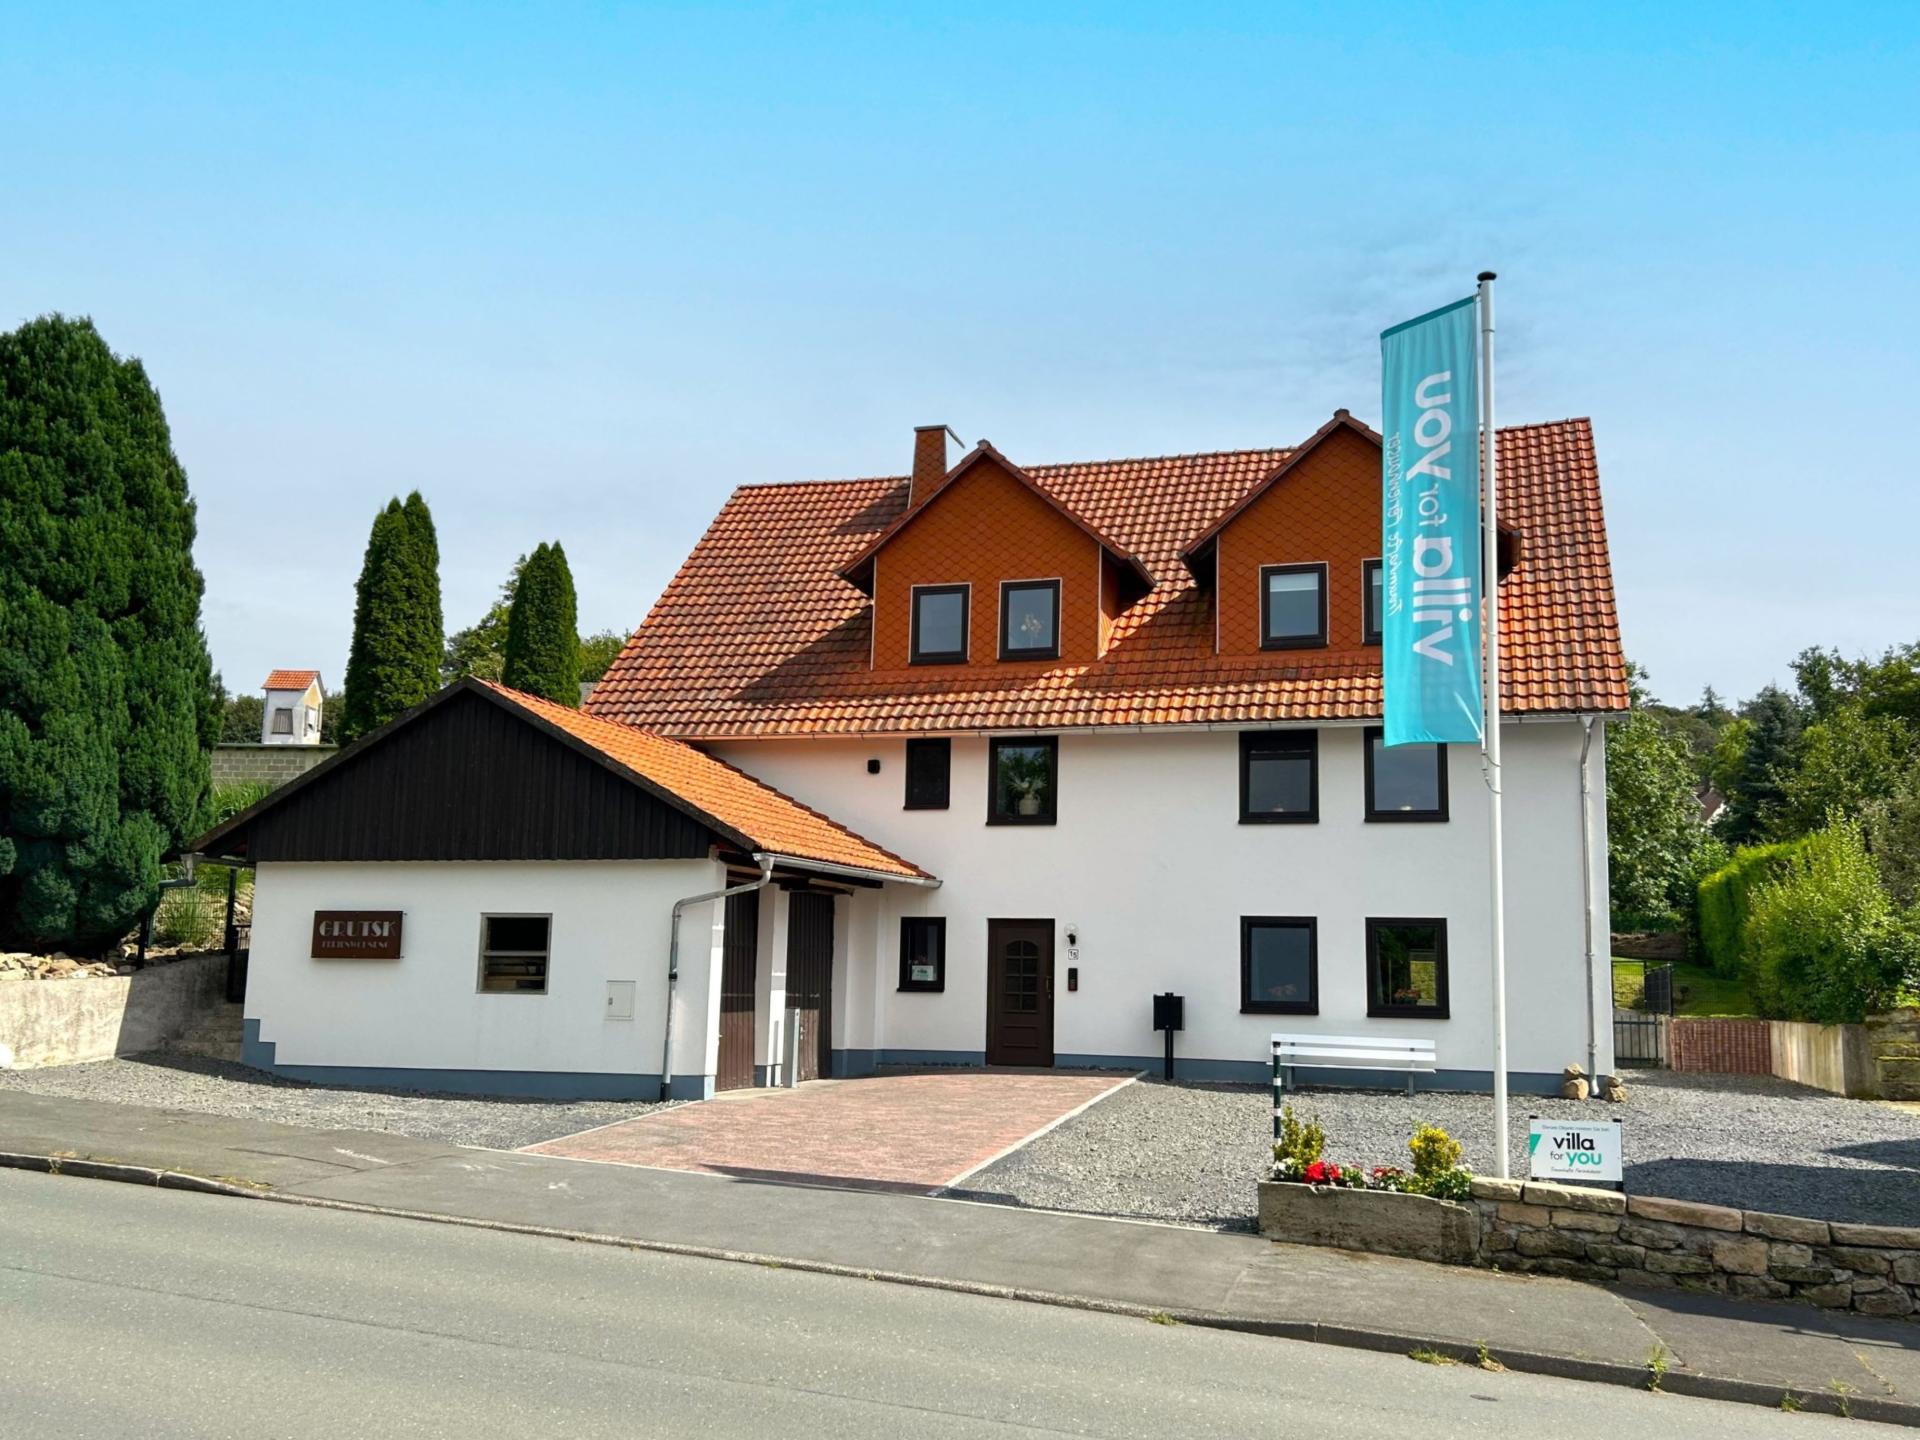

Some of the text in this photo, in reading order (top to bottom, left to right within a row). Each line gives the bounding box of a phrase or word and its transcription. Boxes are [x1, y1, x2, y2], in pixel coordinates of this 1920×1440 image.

[1553, 1132, 1595, 1150] villa
[1550, 1151, 1602, 1167] for you
